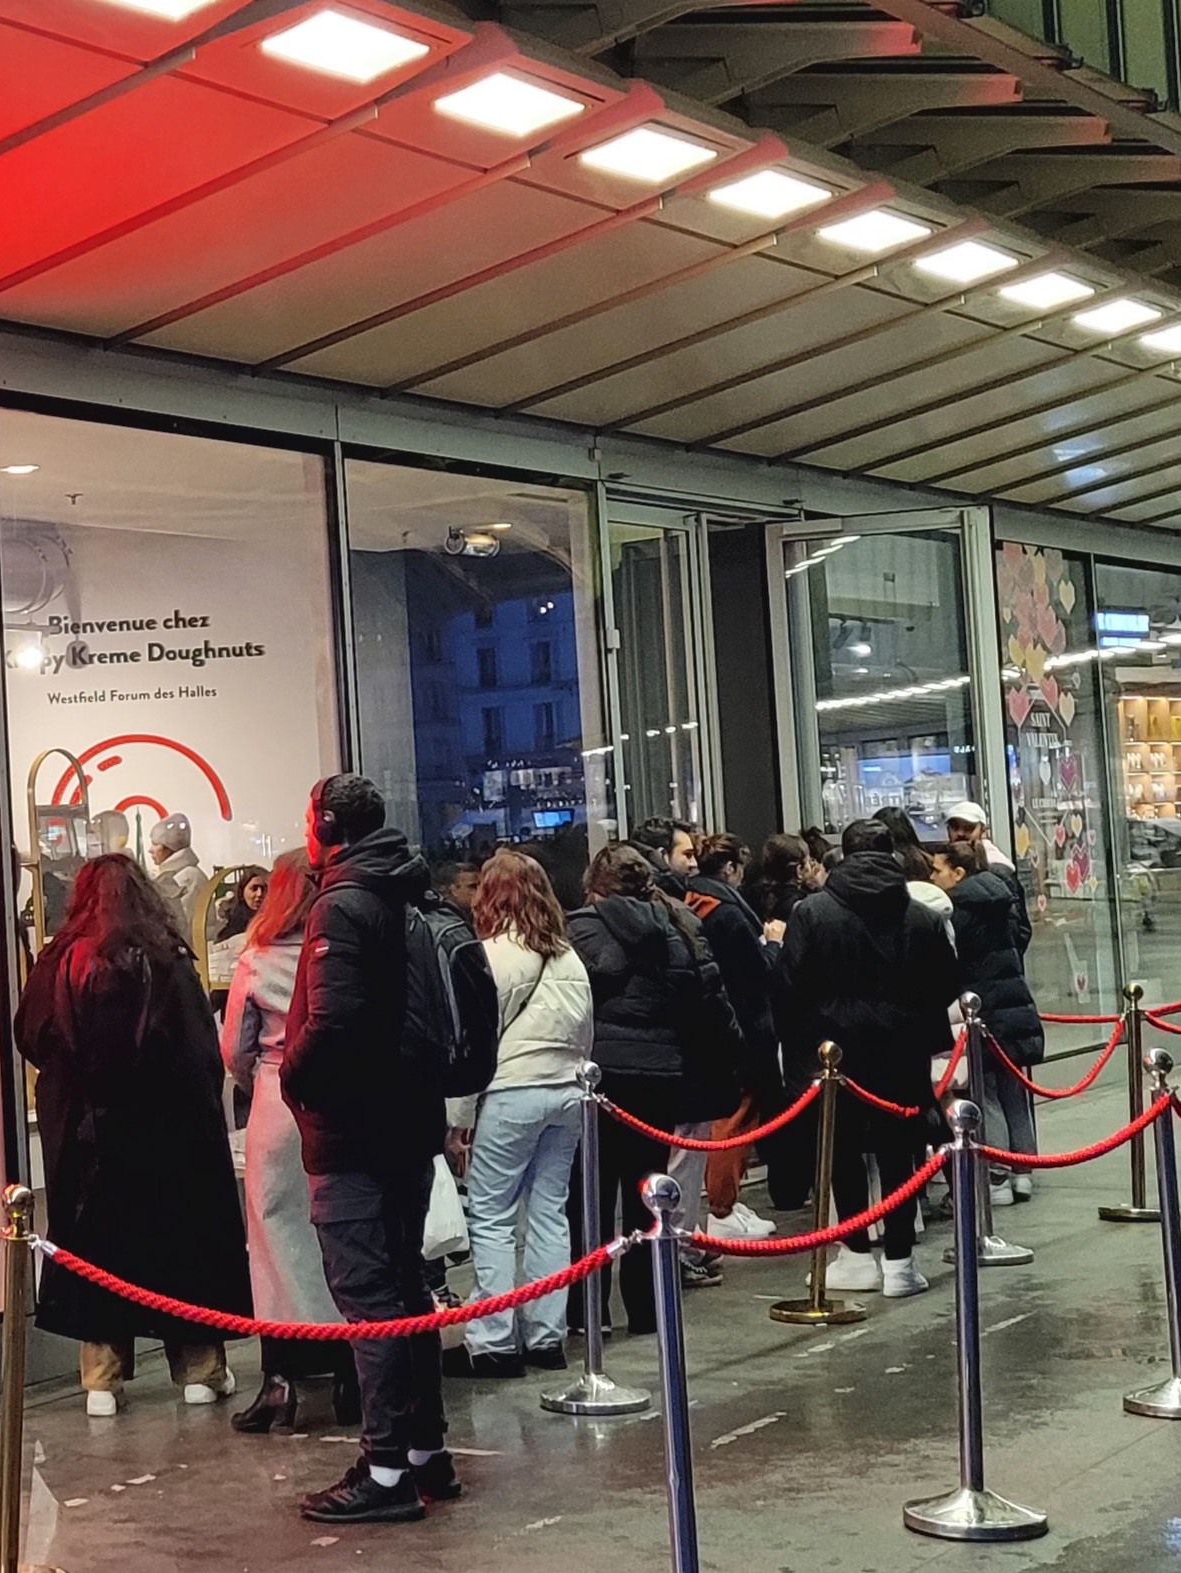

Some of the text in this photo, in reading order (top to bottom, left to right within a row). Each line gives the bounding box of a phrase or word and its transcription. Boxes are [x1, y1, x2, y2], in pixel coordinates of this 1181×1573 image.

[48, 609, 210, 635] Bienvenue chez
[5, 640, 266, 675] Kpy Kreme Doughnuts
[47, 685, 217, 704] Westfield Forum des Halles
[1030, 712, 1050, 727] SAINT
